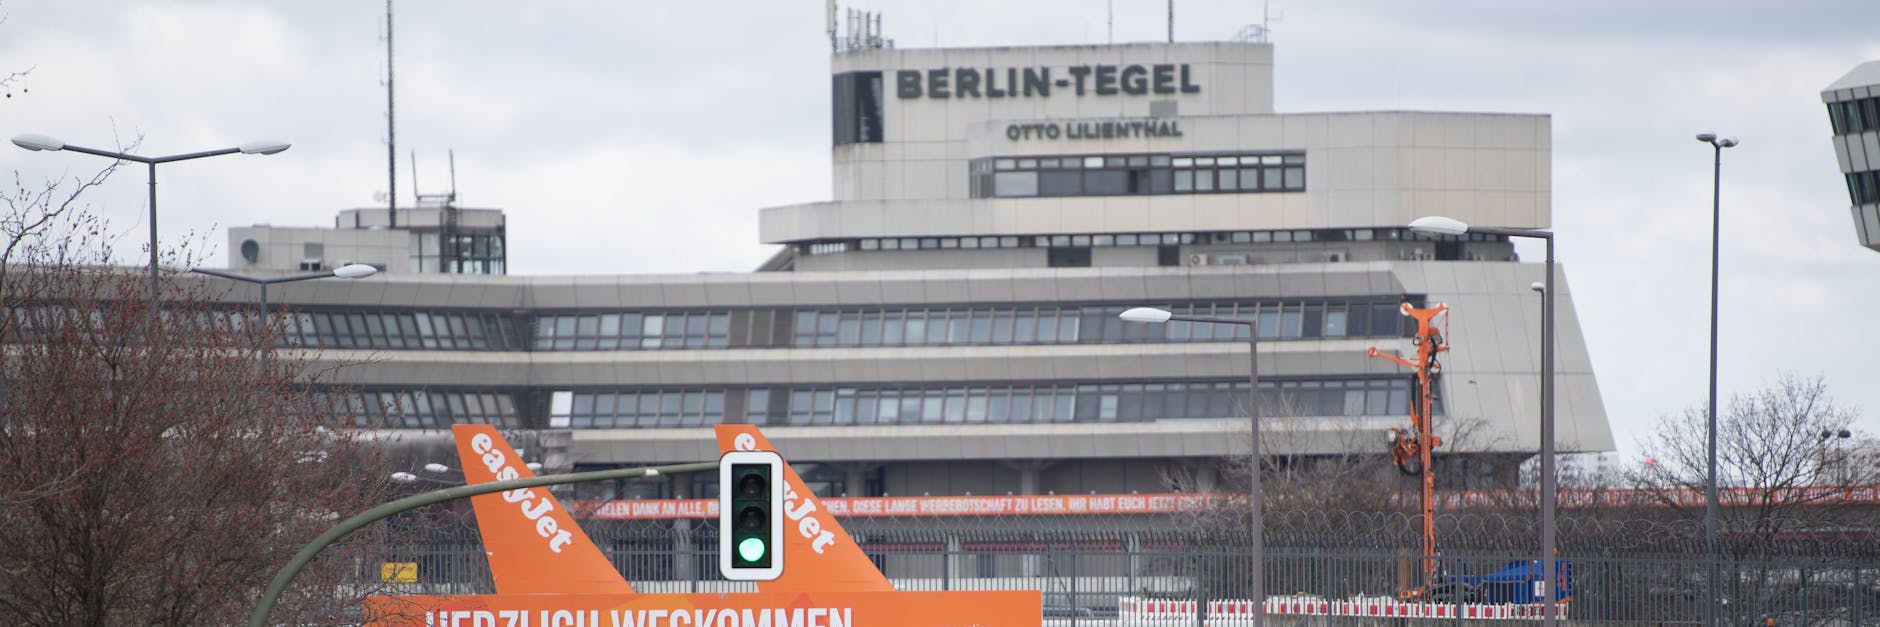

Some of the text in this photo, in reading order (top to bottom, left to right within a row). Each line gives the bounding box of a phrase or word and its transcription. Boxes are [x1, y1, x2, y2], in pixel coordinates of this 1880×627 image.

[896, 64, 1200, 99] BERLIN-TEGEL
[1006, 119, 1183, 141] OTTO LILIENTHAL
[633, 502, 659, 516] DANK
[663, 502, 675, 515] AN
[1015, 497, 1029, 512] ZU
[1069, 496, 1087, 511] IHR
[1089, 496, 1115, 511] HABT
[1118, 496, 1146, 511] EUCH
